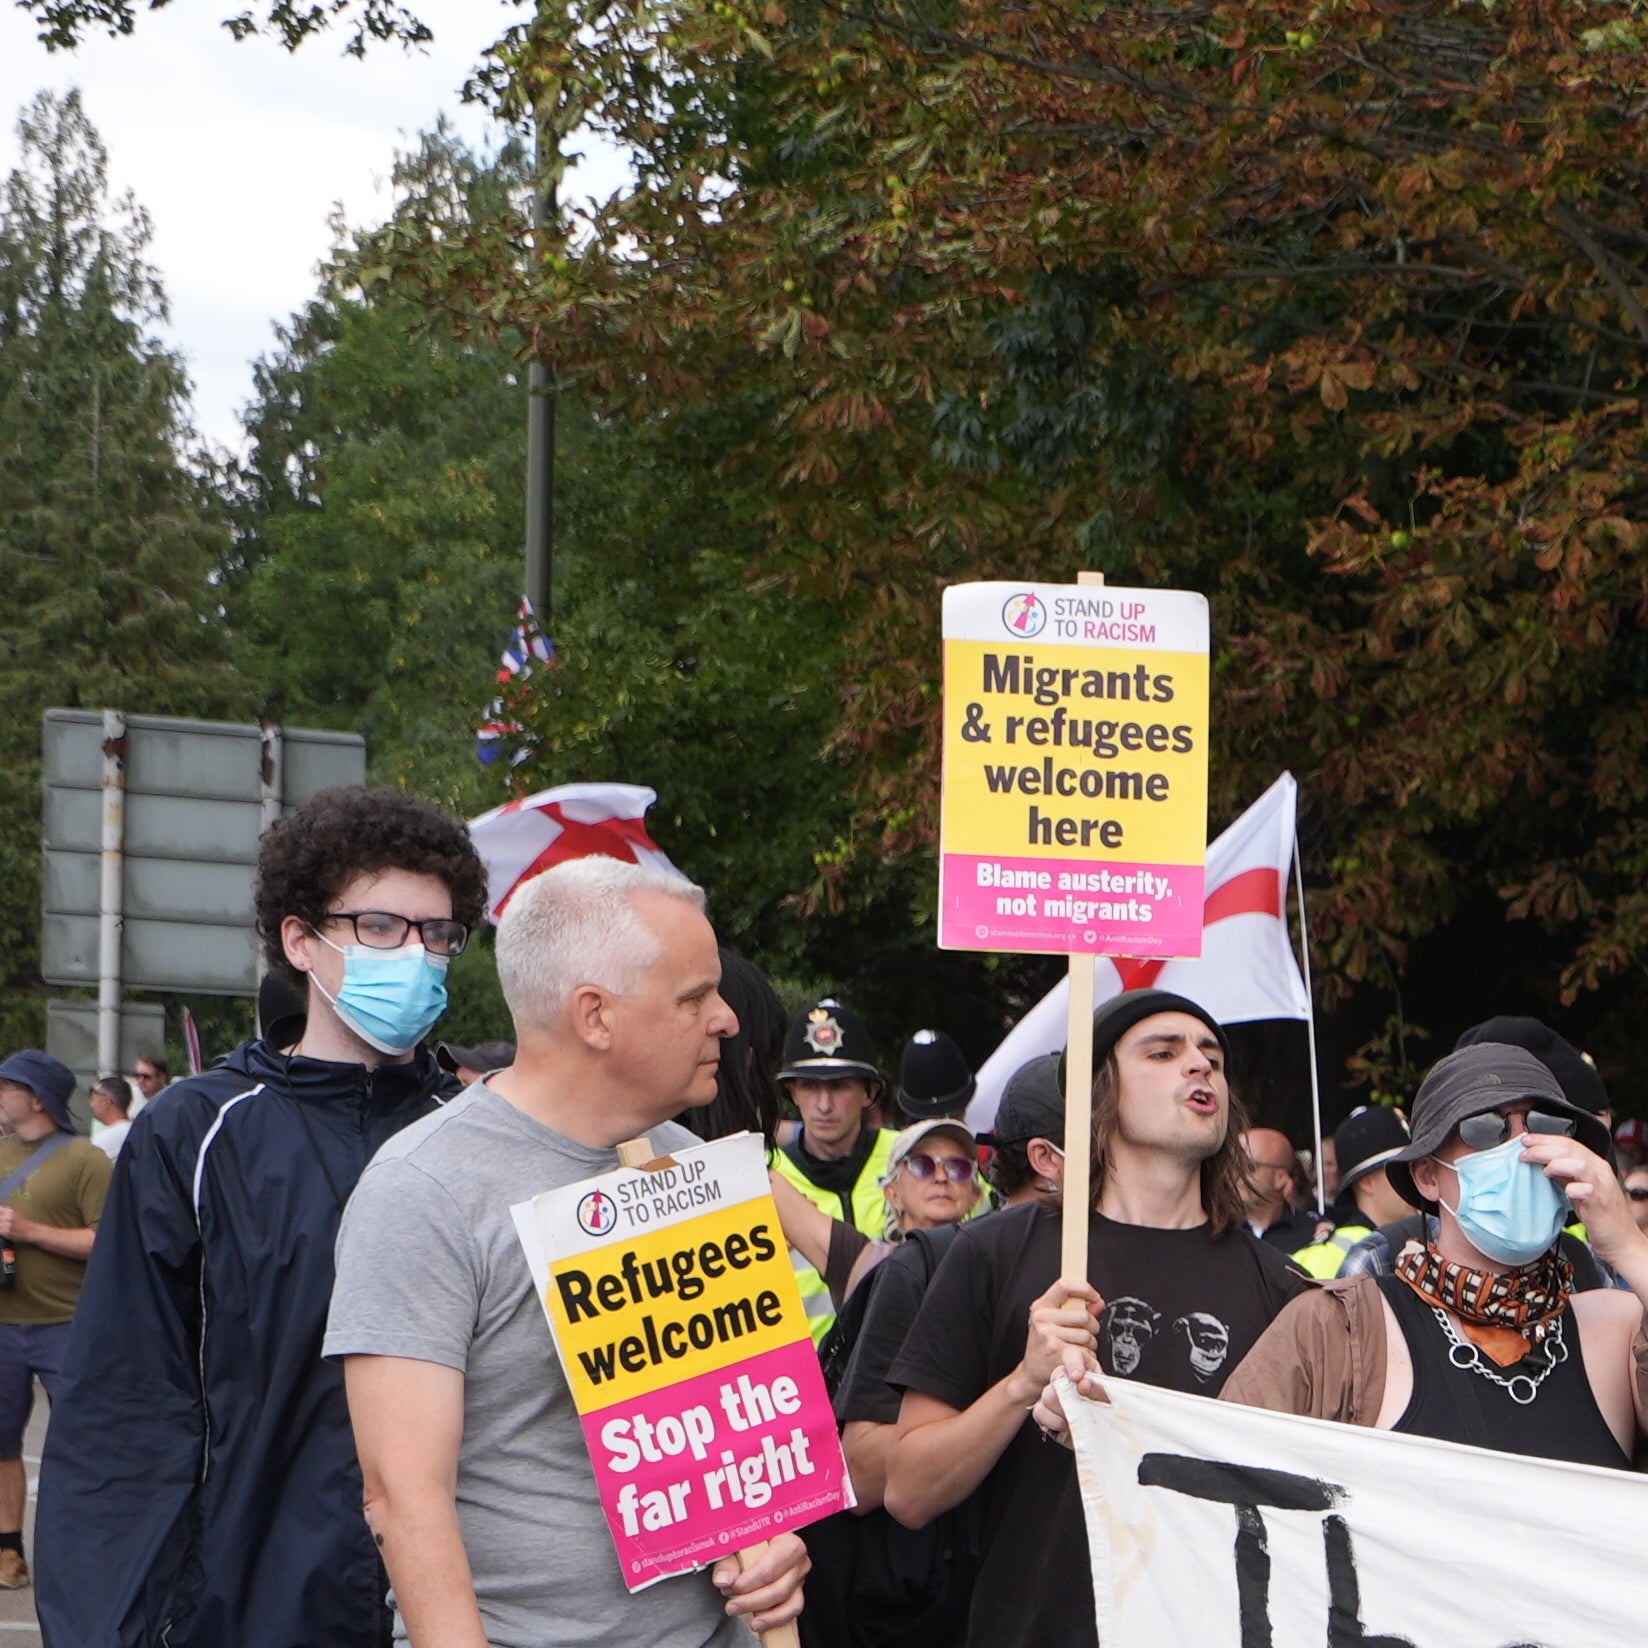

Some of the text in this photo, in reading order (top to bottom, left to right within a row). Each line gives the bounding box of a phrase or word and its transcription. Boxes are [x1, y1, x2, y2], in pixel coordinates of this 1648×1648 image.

[1054, 620, 1156, 643] TO RACISM
[1055, 599, 1145, 620] STAND UP
[983, 653, 1175, 706] Migrants
[961, 702, 1194, 759] & refugees
[984, 757, 1170, 801] welcome
[1028, 806, 1123, 848] here
[976, 862, 1173, 900] Blame austerity,
[996, 894, 1153, 924] not migrants
[616, 1160, 707, 1204] STAND UP
[623, 1179, 722, 1226] TO RACISM
[555, 1224, 776, 1324] Refugees
[577, 1290, 783, 1386] welcome
[600, 1374, 802, 1473] Stop the
[616, 1427, 816, 1538] far right
